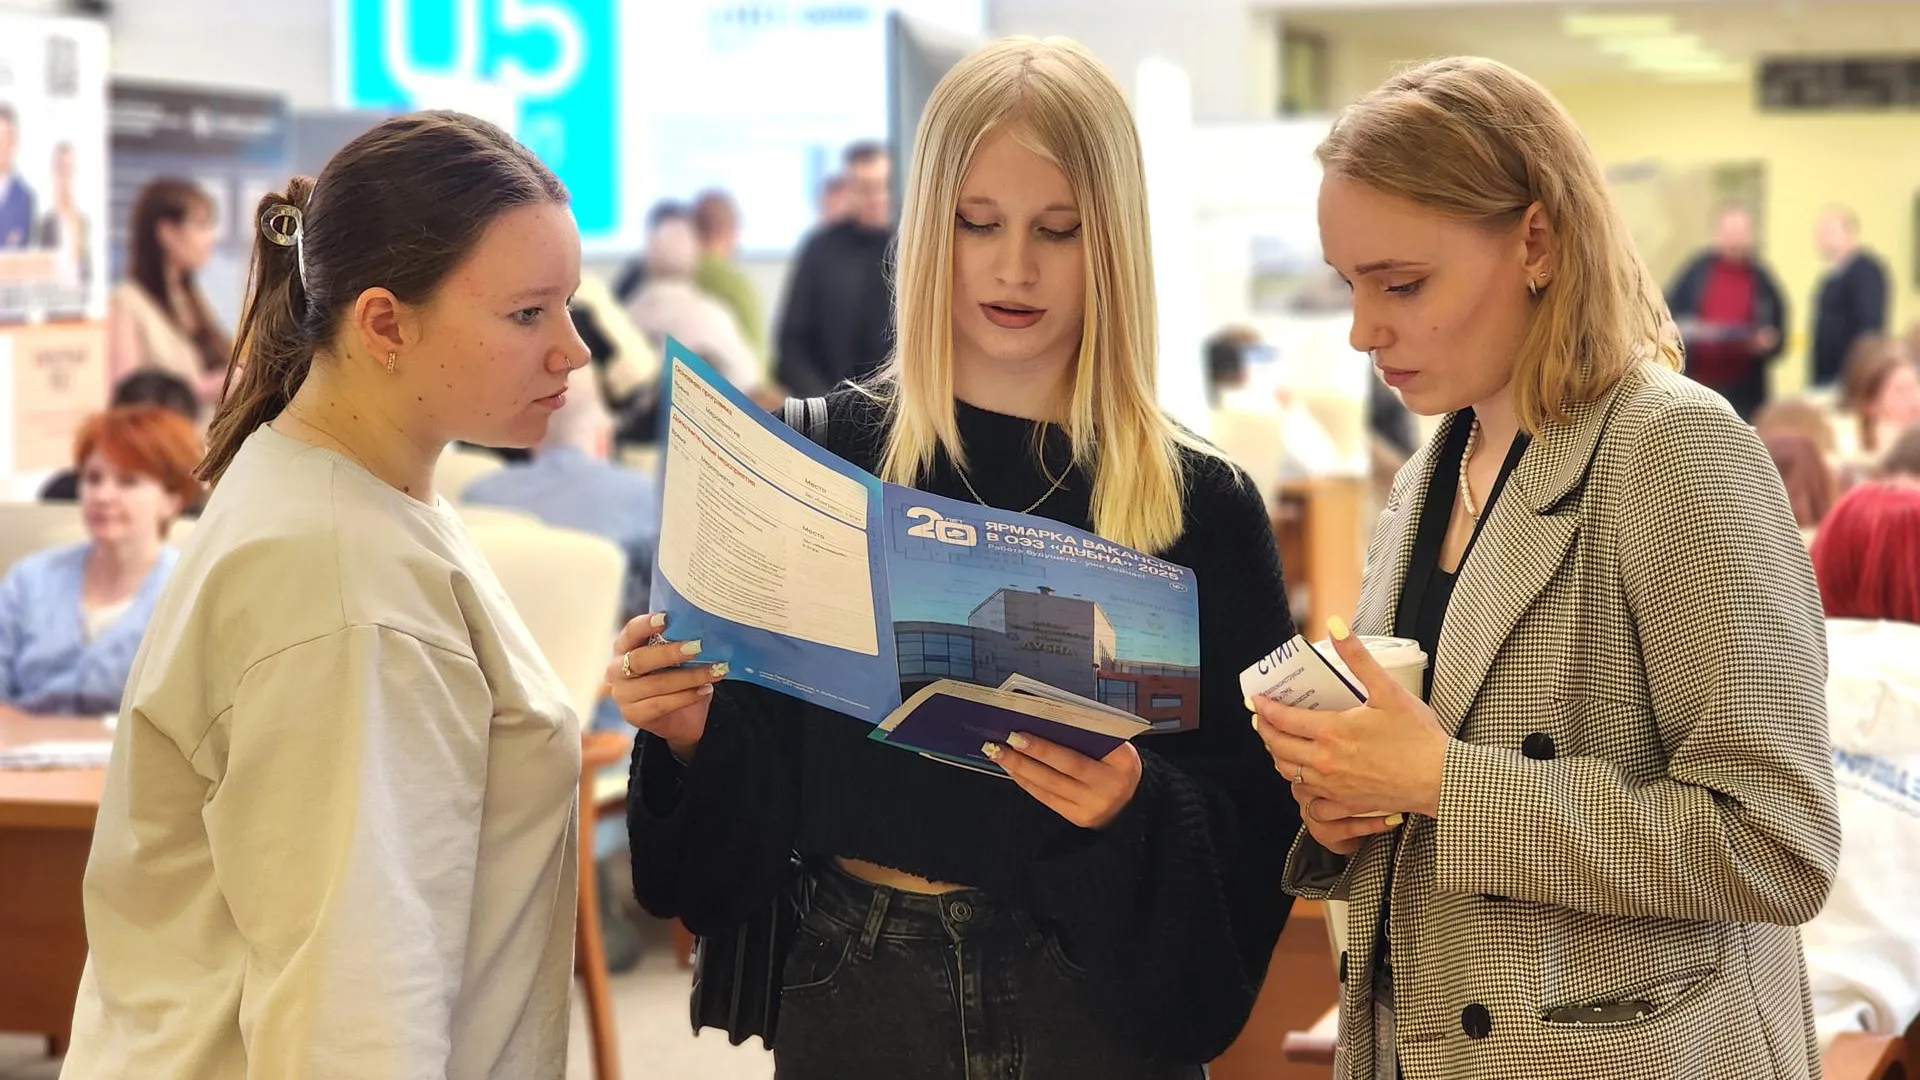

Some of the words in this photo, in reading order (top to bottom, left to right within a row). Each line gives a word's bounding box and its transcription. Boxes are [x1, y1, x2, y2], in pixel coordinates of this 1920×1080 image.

[805, 477, 827, 494] Место
[803, 525, 825, 540] Место
[906, 506, 977, 547] 20
[985, 521, 1077, 545] ЯРМАРКА
[1082, 539, 1184, 576] ВАКАНСИИ
[986, 532, 999, 542] В
[1004, 535, 1045, 549] ОЭЗ
[1050, 544, 1132, 567] «ДУБНА»
[1138, 563, 1179, 581] 2025
